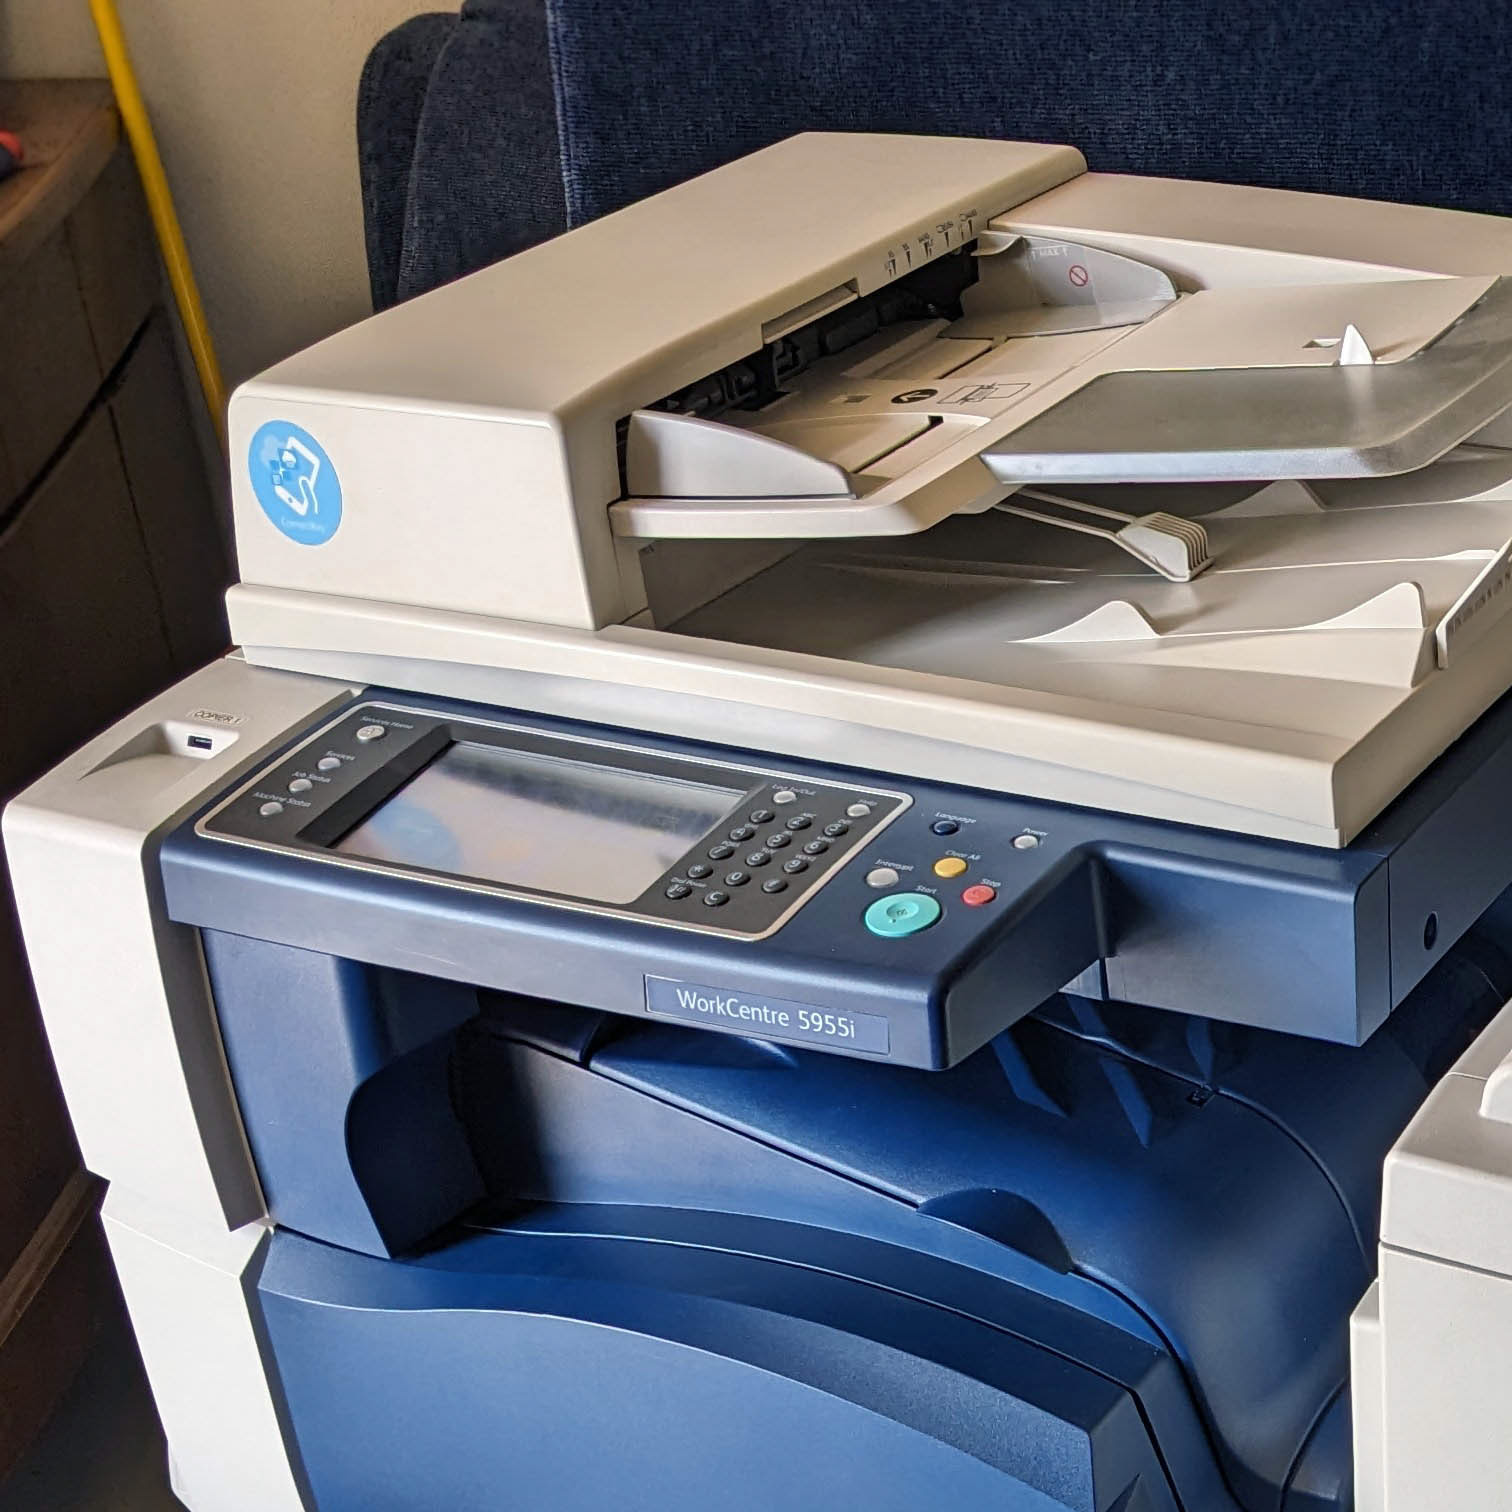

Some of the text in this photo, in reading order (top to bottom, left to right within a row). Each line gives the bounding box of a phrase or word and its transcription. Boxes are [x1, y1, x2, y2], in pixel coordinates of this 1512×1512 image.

[934, 811, 977, 824] Language
[1022, 827, 1049, 837] Power
[944, 849, 981, 861] Clear All
[874, 858, 915, 872] Interrupt
[980, 877, 1002, 888] Stop
[915, 884, 938, 895] Start
[675, 987, 856, 1039] WorkCentre 5955i
